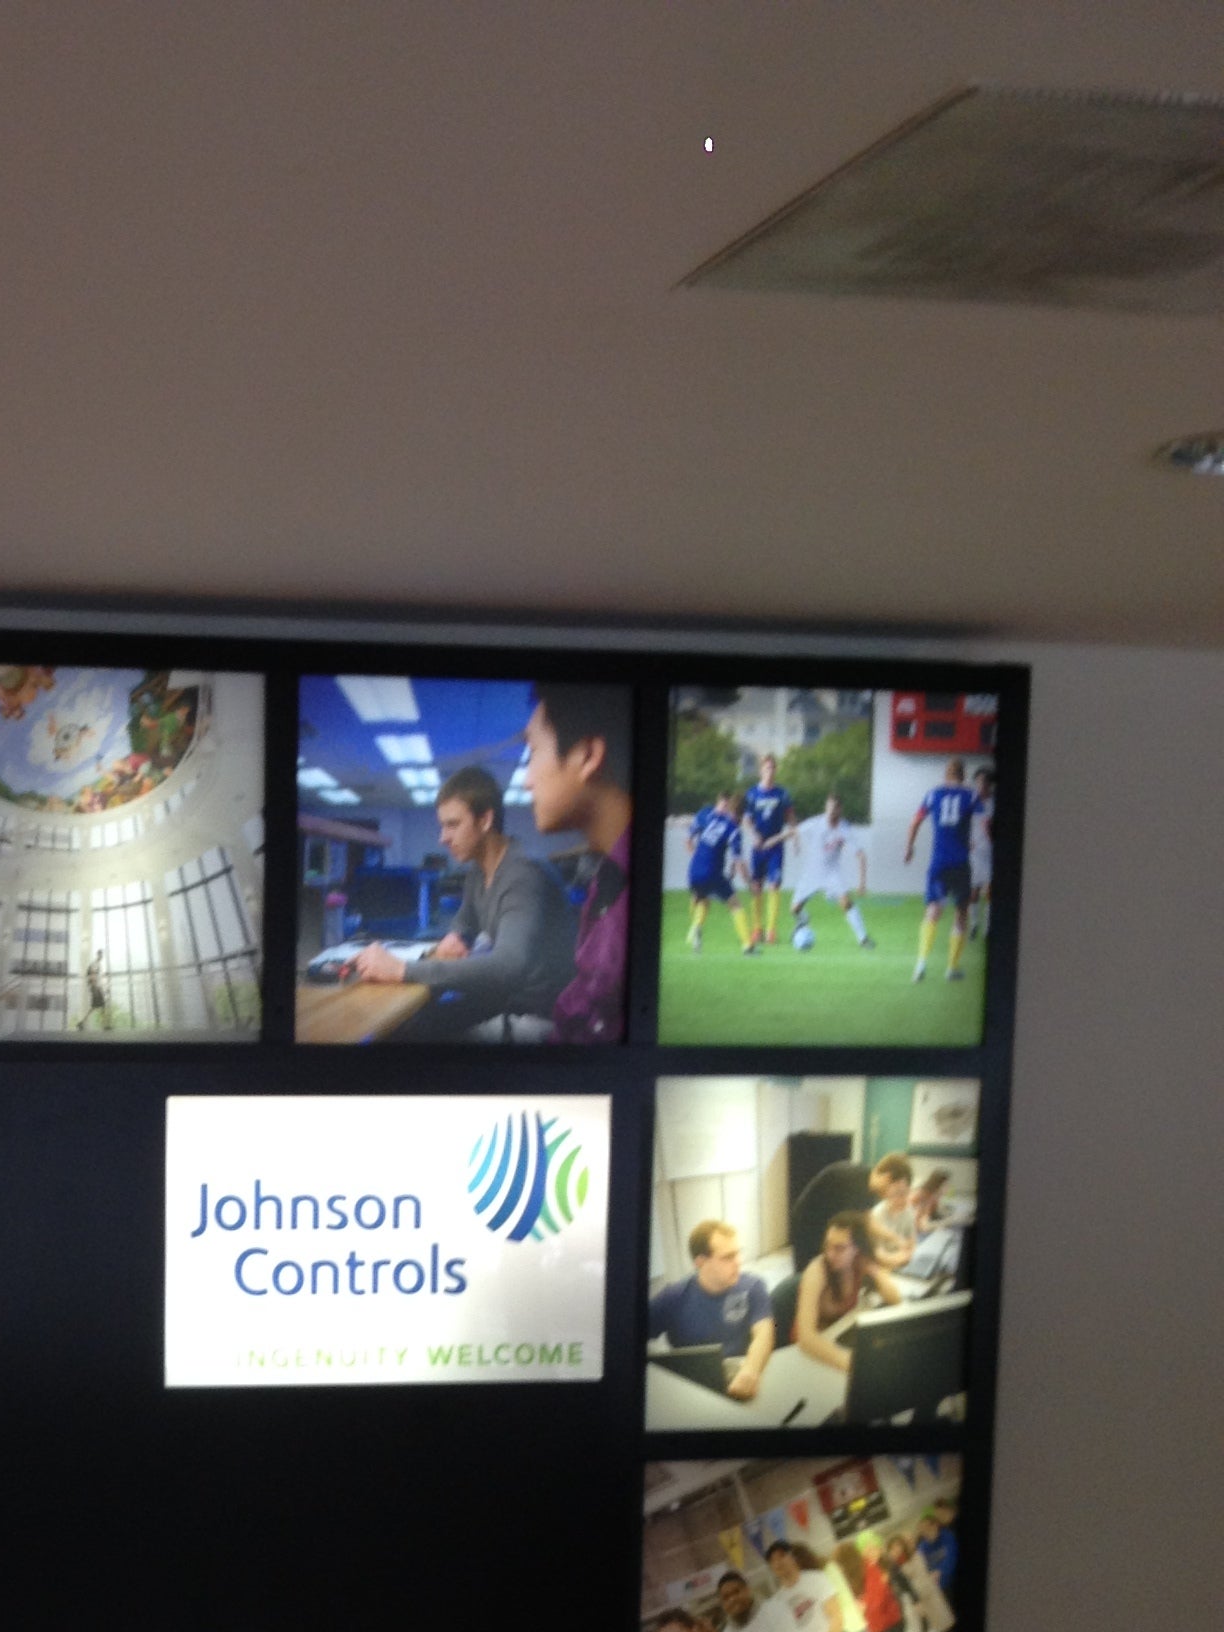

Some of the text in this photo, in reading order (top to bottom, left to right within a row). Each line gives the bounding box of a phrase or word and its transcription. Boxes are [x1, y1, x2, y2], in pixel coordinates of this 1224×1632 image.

[190, 1179, 423, 1239] Johnson
[233, 1243, 468, 1297] Controls
[234, 1342, 584, 1370] INGENUITY WELCOME
